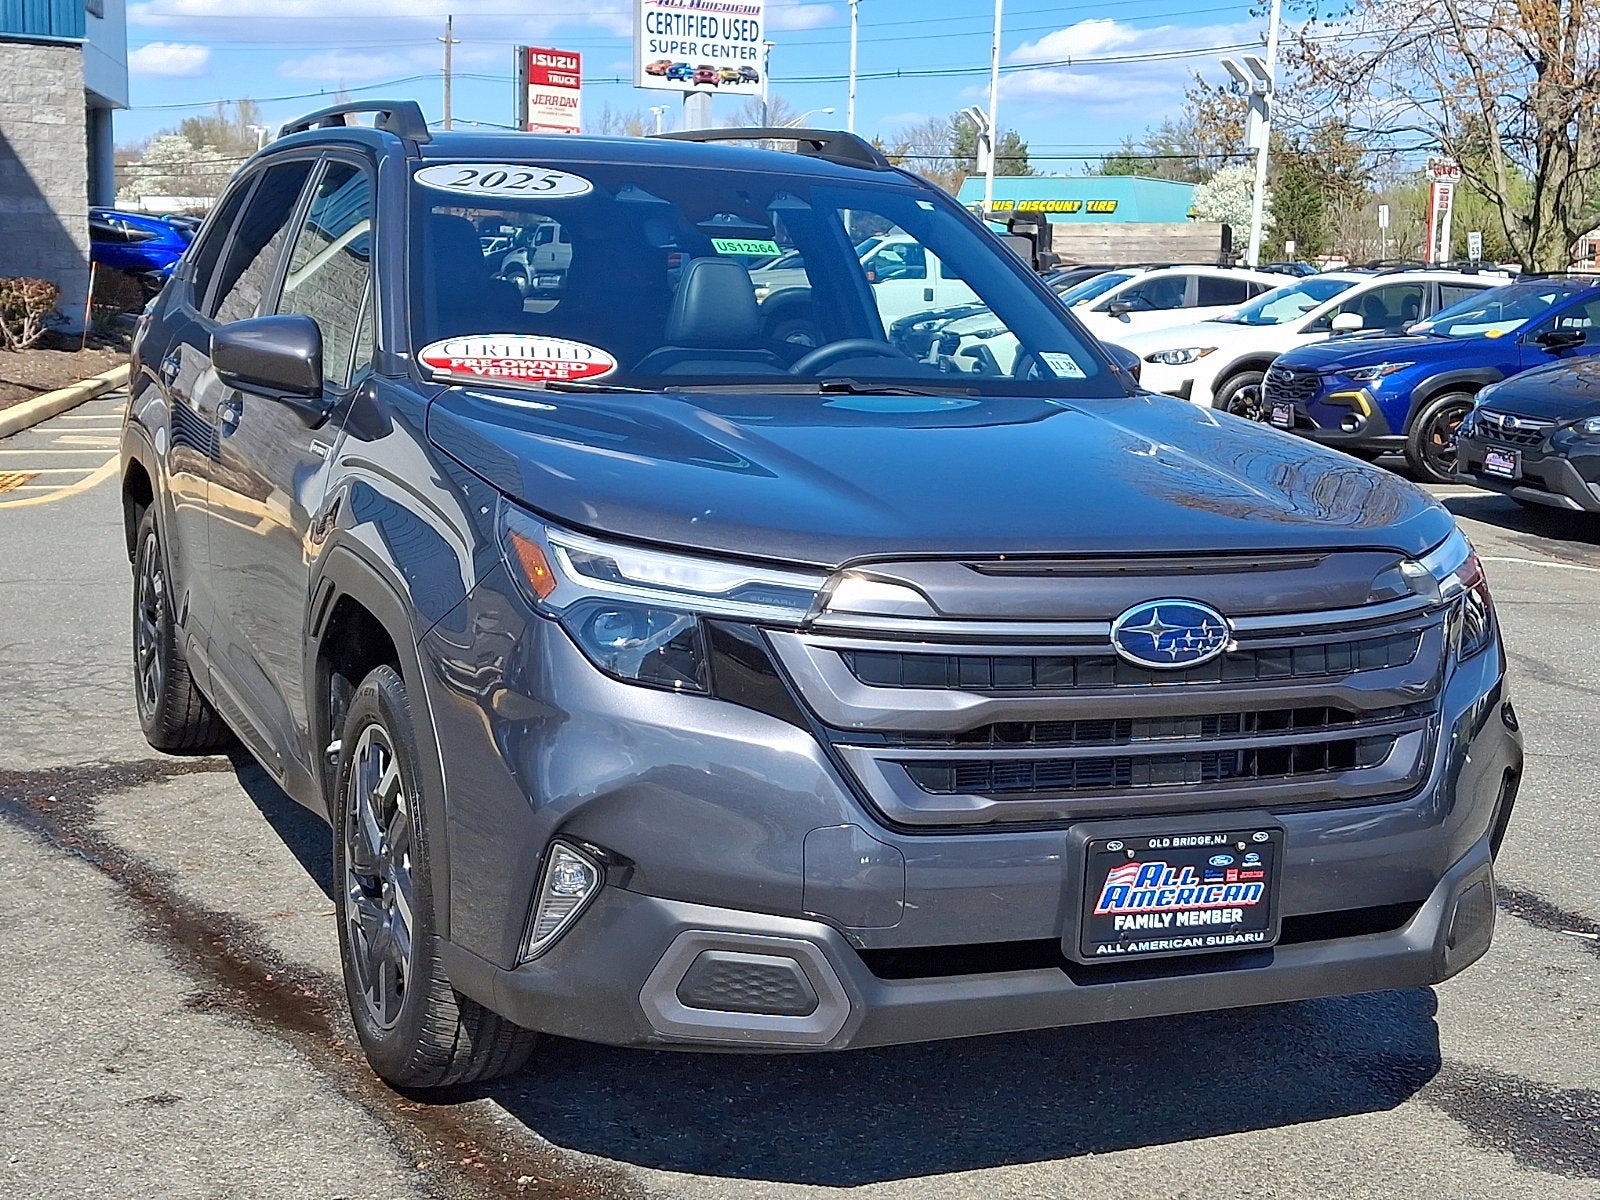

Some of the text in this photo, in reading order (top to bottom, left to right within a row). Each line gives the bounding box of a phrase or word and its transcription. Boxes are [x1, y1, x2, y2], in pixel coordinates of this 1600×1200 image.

[646, 11, 759, 42] CERTIFIED USED
[649, 39, 757, 60] SUPER CENTER
[532, 53, 577, 69] ISUZU
[547, 74, 577, 86] TRUCK
[447, 169, 563, 191] 2025
[1018, 200, 1082, 213] DISCOUNT
[1086, 200, 1118, 213] TIRE
[716, 241, 775, 253] US12364
[443, 343, 592, 360] CERTIFIED
[450, 357, 588, 371] PRE-OWNED
[471, 366, 570, 379] VEHICLE
[750, 595, 796, 606] SUBARU
[1148, 838, 1170, 848] OLD
[1134, 862, 1200, 888] ALL
[1099, 882, 1265, 911] AMERICAN
[1114, 908, 1243, 931] FAMILY MEMBER
[1096, 932, 1264, 954] ALL AMERICAN SUBARU
